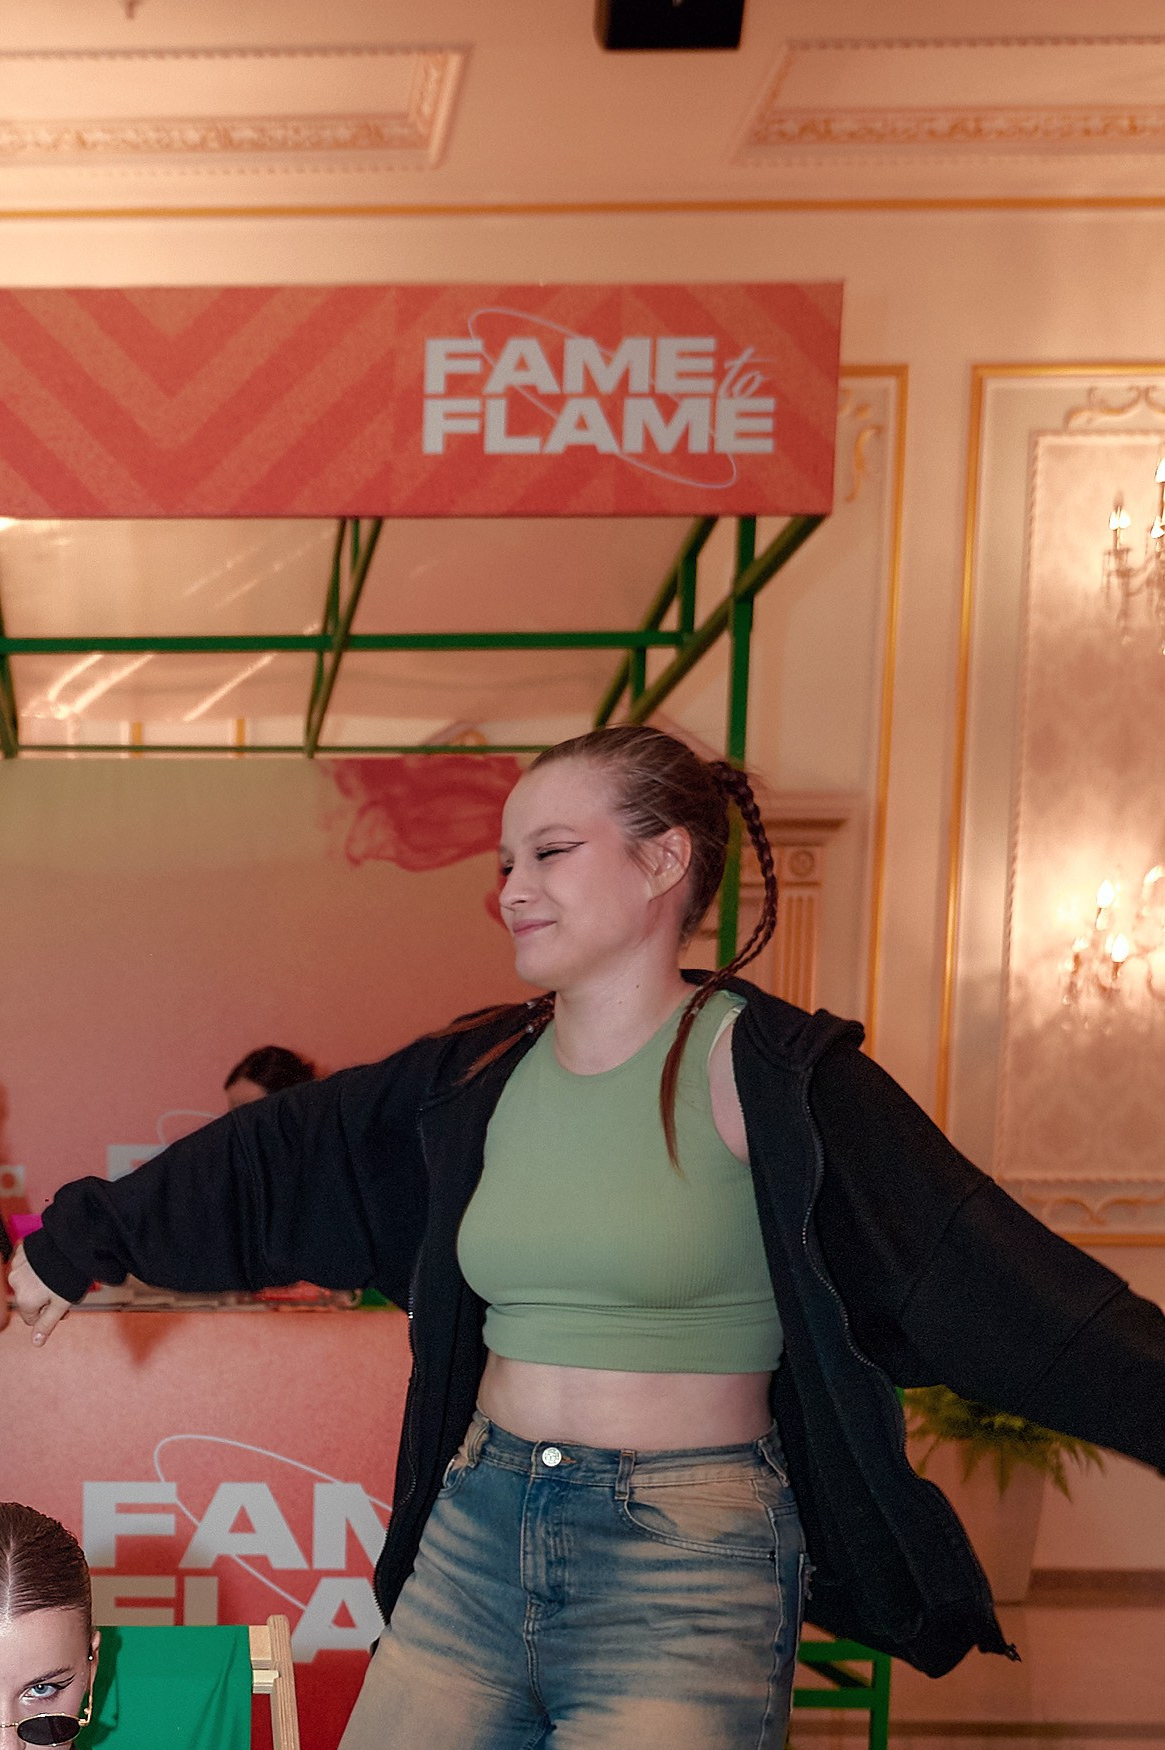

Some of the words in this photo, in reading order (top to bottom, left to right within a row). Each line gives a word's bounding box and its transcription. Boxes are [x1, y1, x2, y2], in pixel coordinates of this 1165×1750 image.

[423, 335, 717, 395] FAME
[717, 344, 776, 399] to
[422, 396, 776, 455] FLAME
[82, 1481, 388, 1569] FAM
